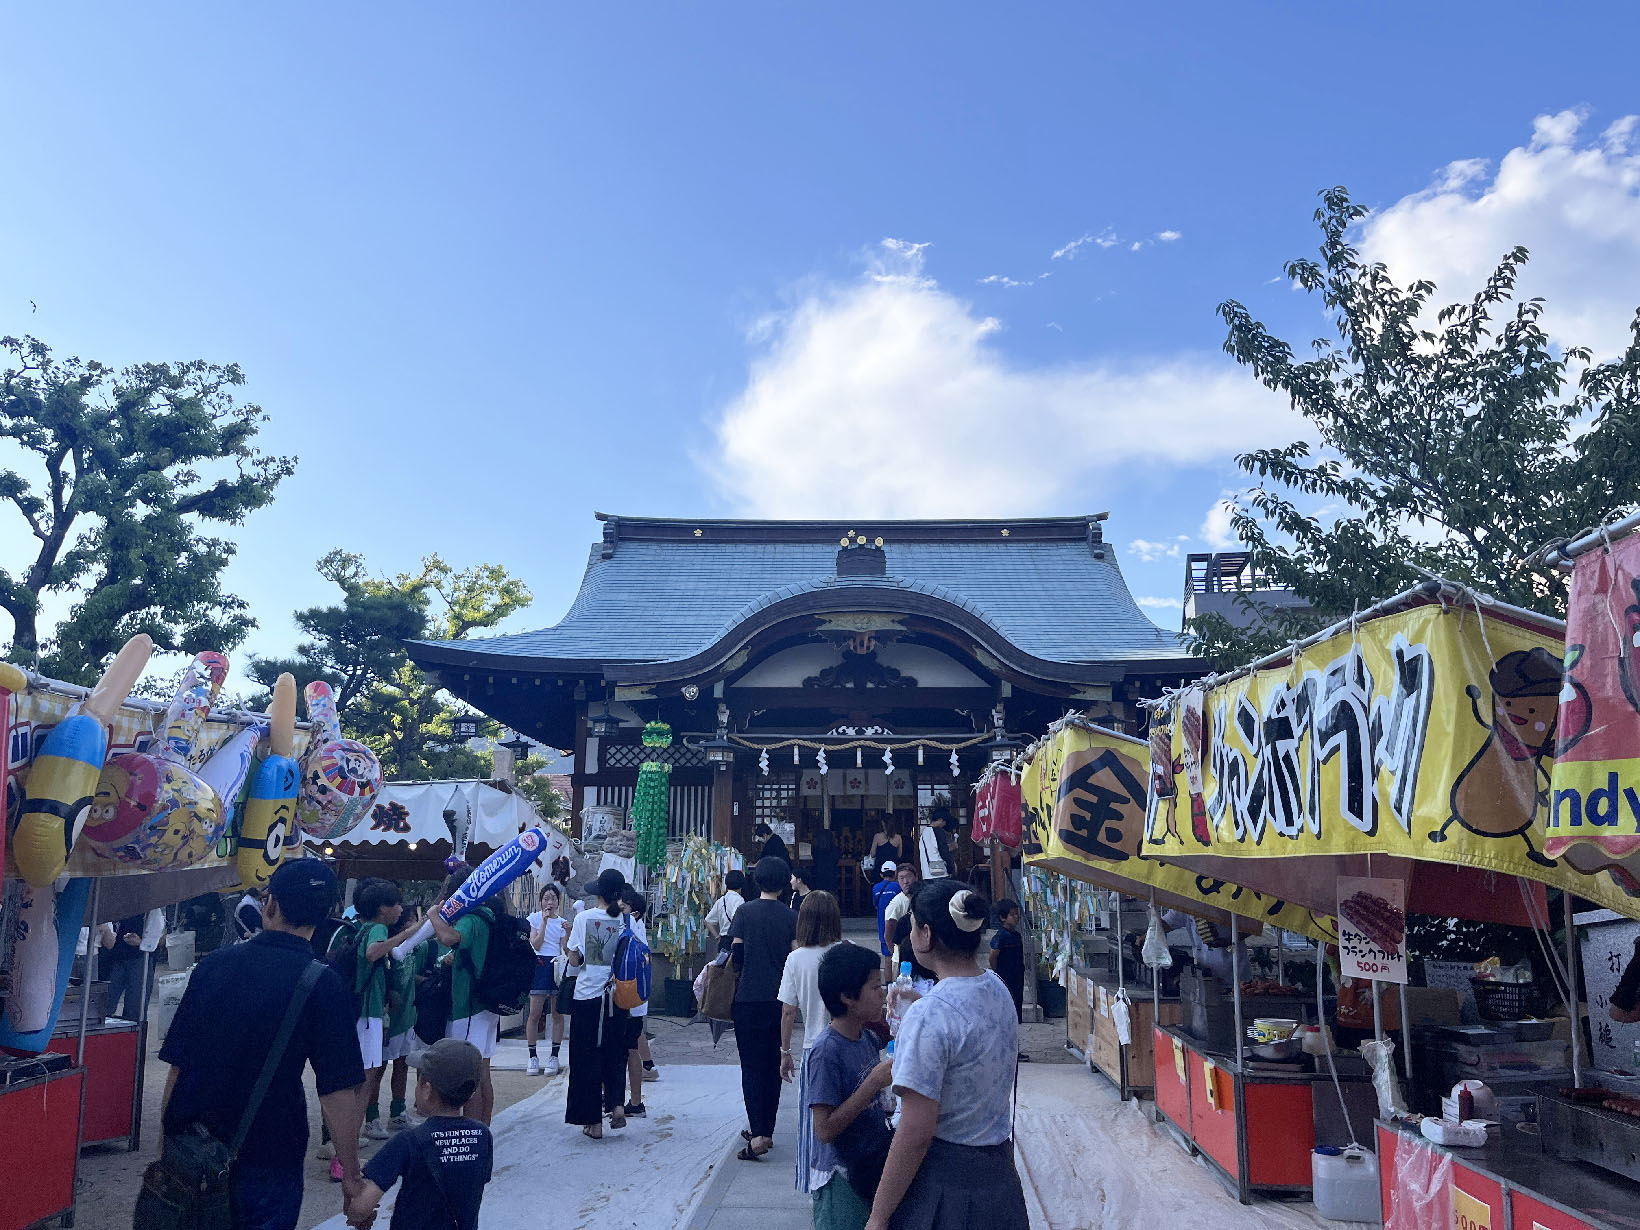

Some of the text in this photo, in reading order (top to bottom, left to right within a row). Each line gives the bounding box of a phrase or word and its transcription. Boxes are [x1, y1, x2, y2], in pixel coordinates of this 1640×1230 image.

[1057, 749, 1149, 860] 金
[370, 801, 411, 833] 焼
[468, 845, 522, 897] Homerun
[1356, 960, 1390, 974] 500円
[441, 1146, 459, 1155] AND
[451, 1137, 478, 1145] PLACES
